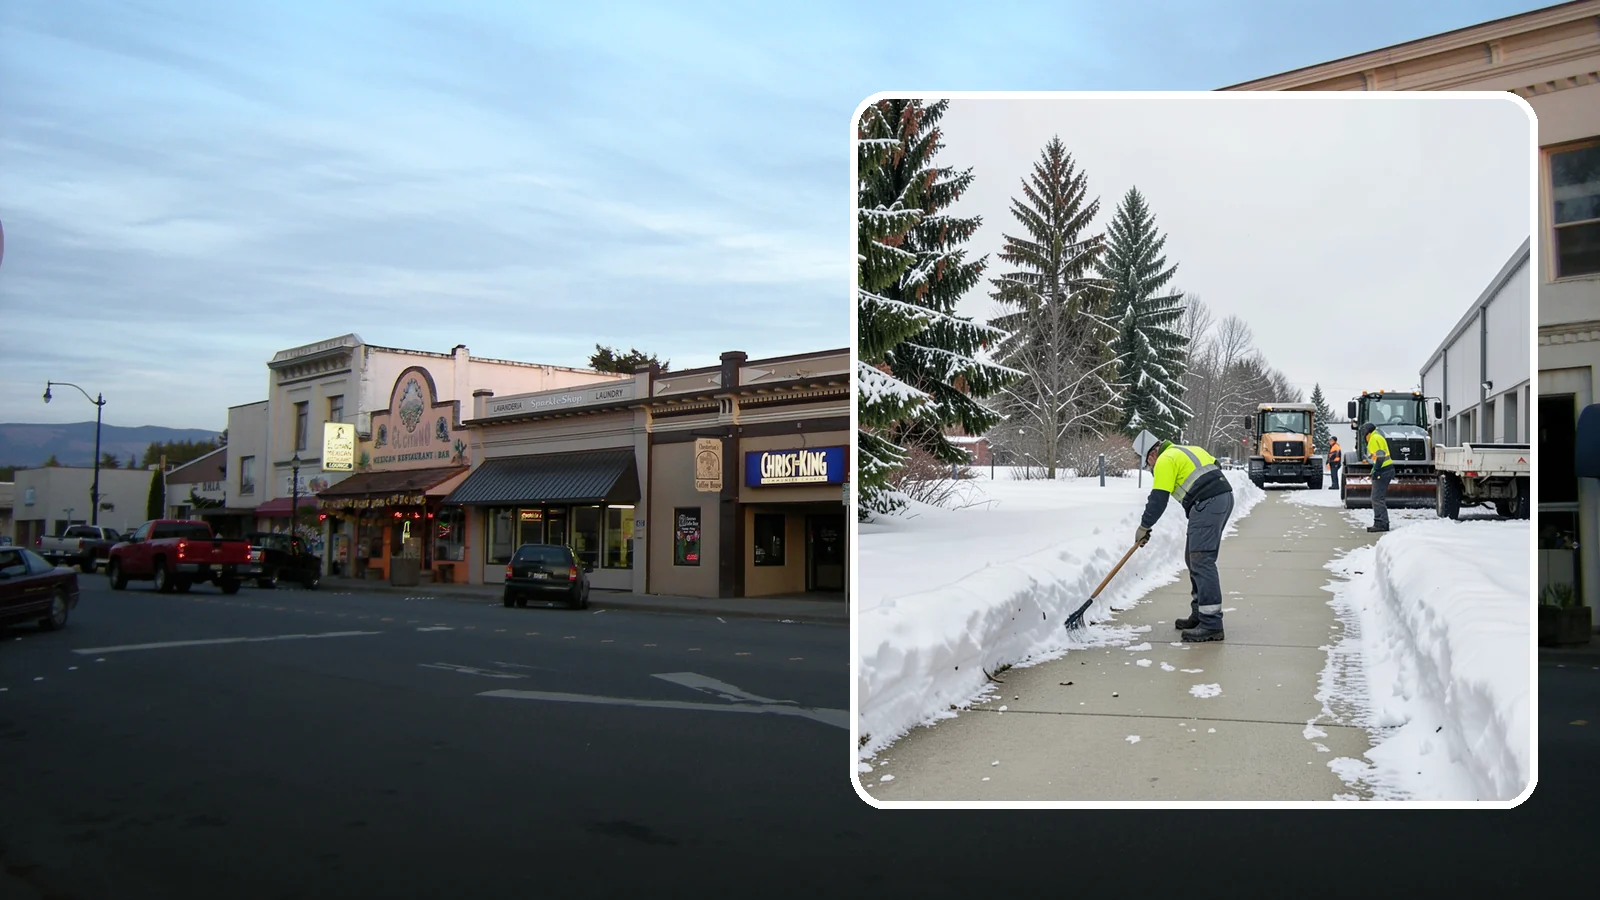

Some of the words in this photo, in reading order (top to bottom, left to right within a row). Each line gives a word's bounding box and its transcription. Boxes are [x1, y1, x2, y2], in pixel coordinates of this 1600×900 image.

[561, 395, 582, 405] Shop
[595, 389, 623, 400] LAUNDRY
[493, 402, 522, 412] LAVANDERIA
[373, 455, 396, 464] MEXICAN
[397, 451, 433, 462] RESTAURANT
[437, 450, 450, 459] BAR
[761, 452, 798, 478] CHRIST
[799, 450, 827, 476] KING
